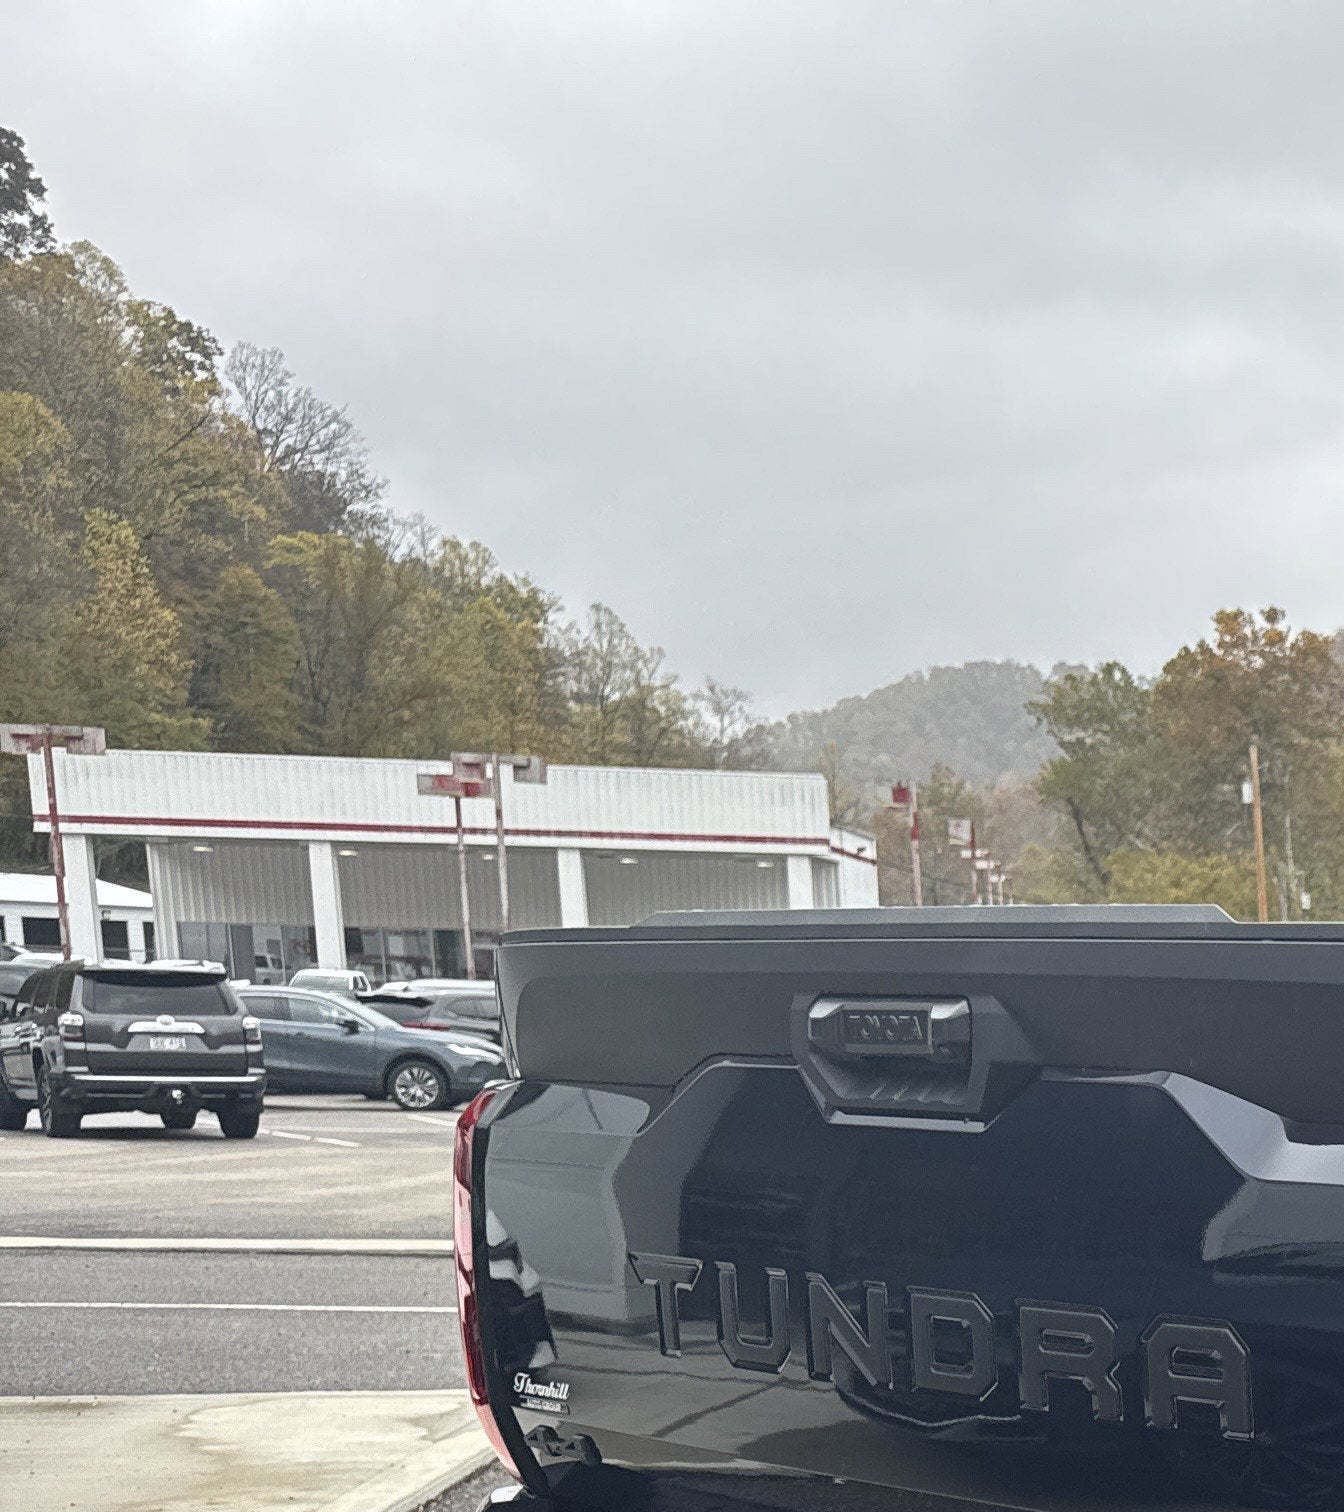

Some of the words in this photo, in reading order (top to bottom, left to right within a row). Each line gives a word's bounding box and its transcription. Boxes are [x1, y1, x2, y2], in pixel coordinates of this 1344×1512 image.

[847, 1013, 924, 1042] TOYOTA
[626, 1251, 1256, 1440] TUNDRA
[513, 1371, 570, 1401] Thornhill
